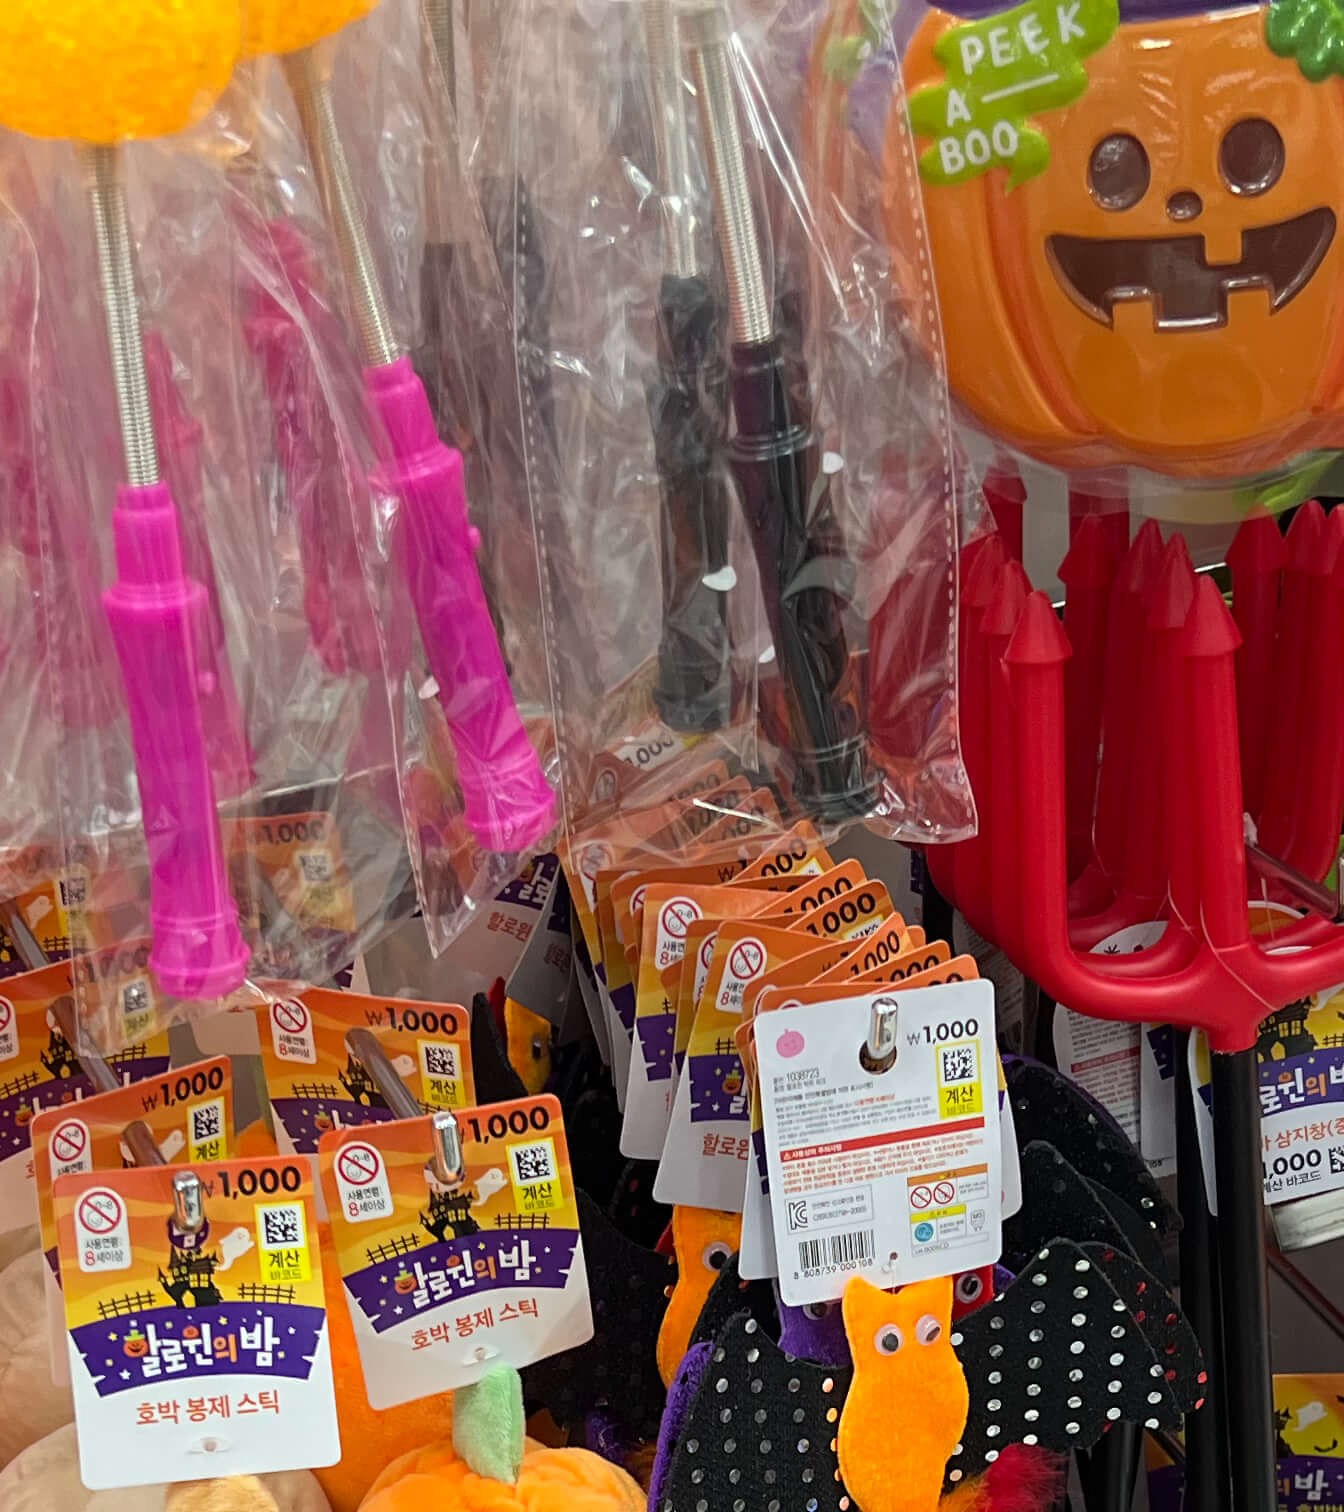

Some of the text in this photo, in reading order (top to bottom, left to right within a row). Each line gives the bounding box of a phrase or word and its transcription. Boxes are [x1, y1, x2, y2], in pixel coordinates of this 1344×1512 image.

[959, 2, 1086, 76] PEEK
[945, 88, 973, 127] A
[938, 119, 1020, 176] BOO
[661, 940, 685, 952] 사용연
[850, 931, 900, 976] 1000
[906, 1018, 979, 1046] ₩1,000
[429, 1079, 456, 1095] 계산
[946, 1086, 975, 1105] 계산
[1259, 1067, 1327, 1115] 로윈의
[461, 1105, 550, 1145] 1,000
[194, 1142, 220, 1161] 계산
[521, 1184, 553, 1200] 계산
[1286, 1170, 1323, 1188] 바코드
[268, 1252, 300, 1269] 계산
[498, 1239, 537, 1281] 밤
[239, 1316, 281, 1367] 밤
[411, 1297, 540, 1351] 호박 봉제 스틱
[136, 1389, 281, 1426] 호박 봉제 스틱
[1294, 1469, 1329, 1500] 밤
